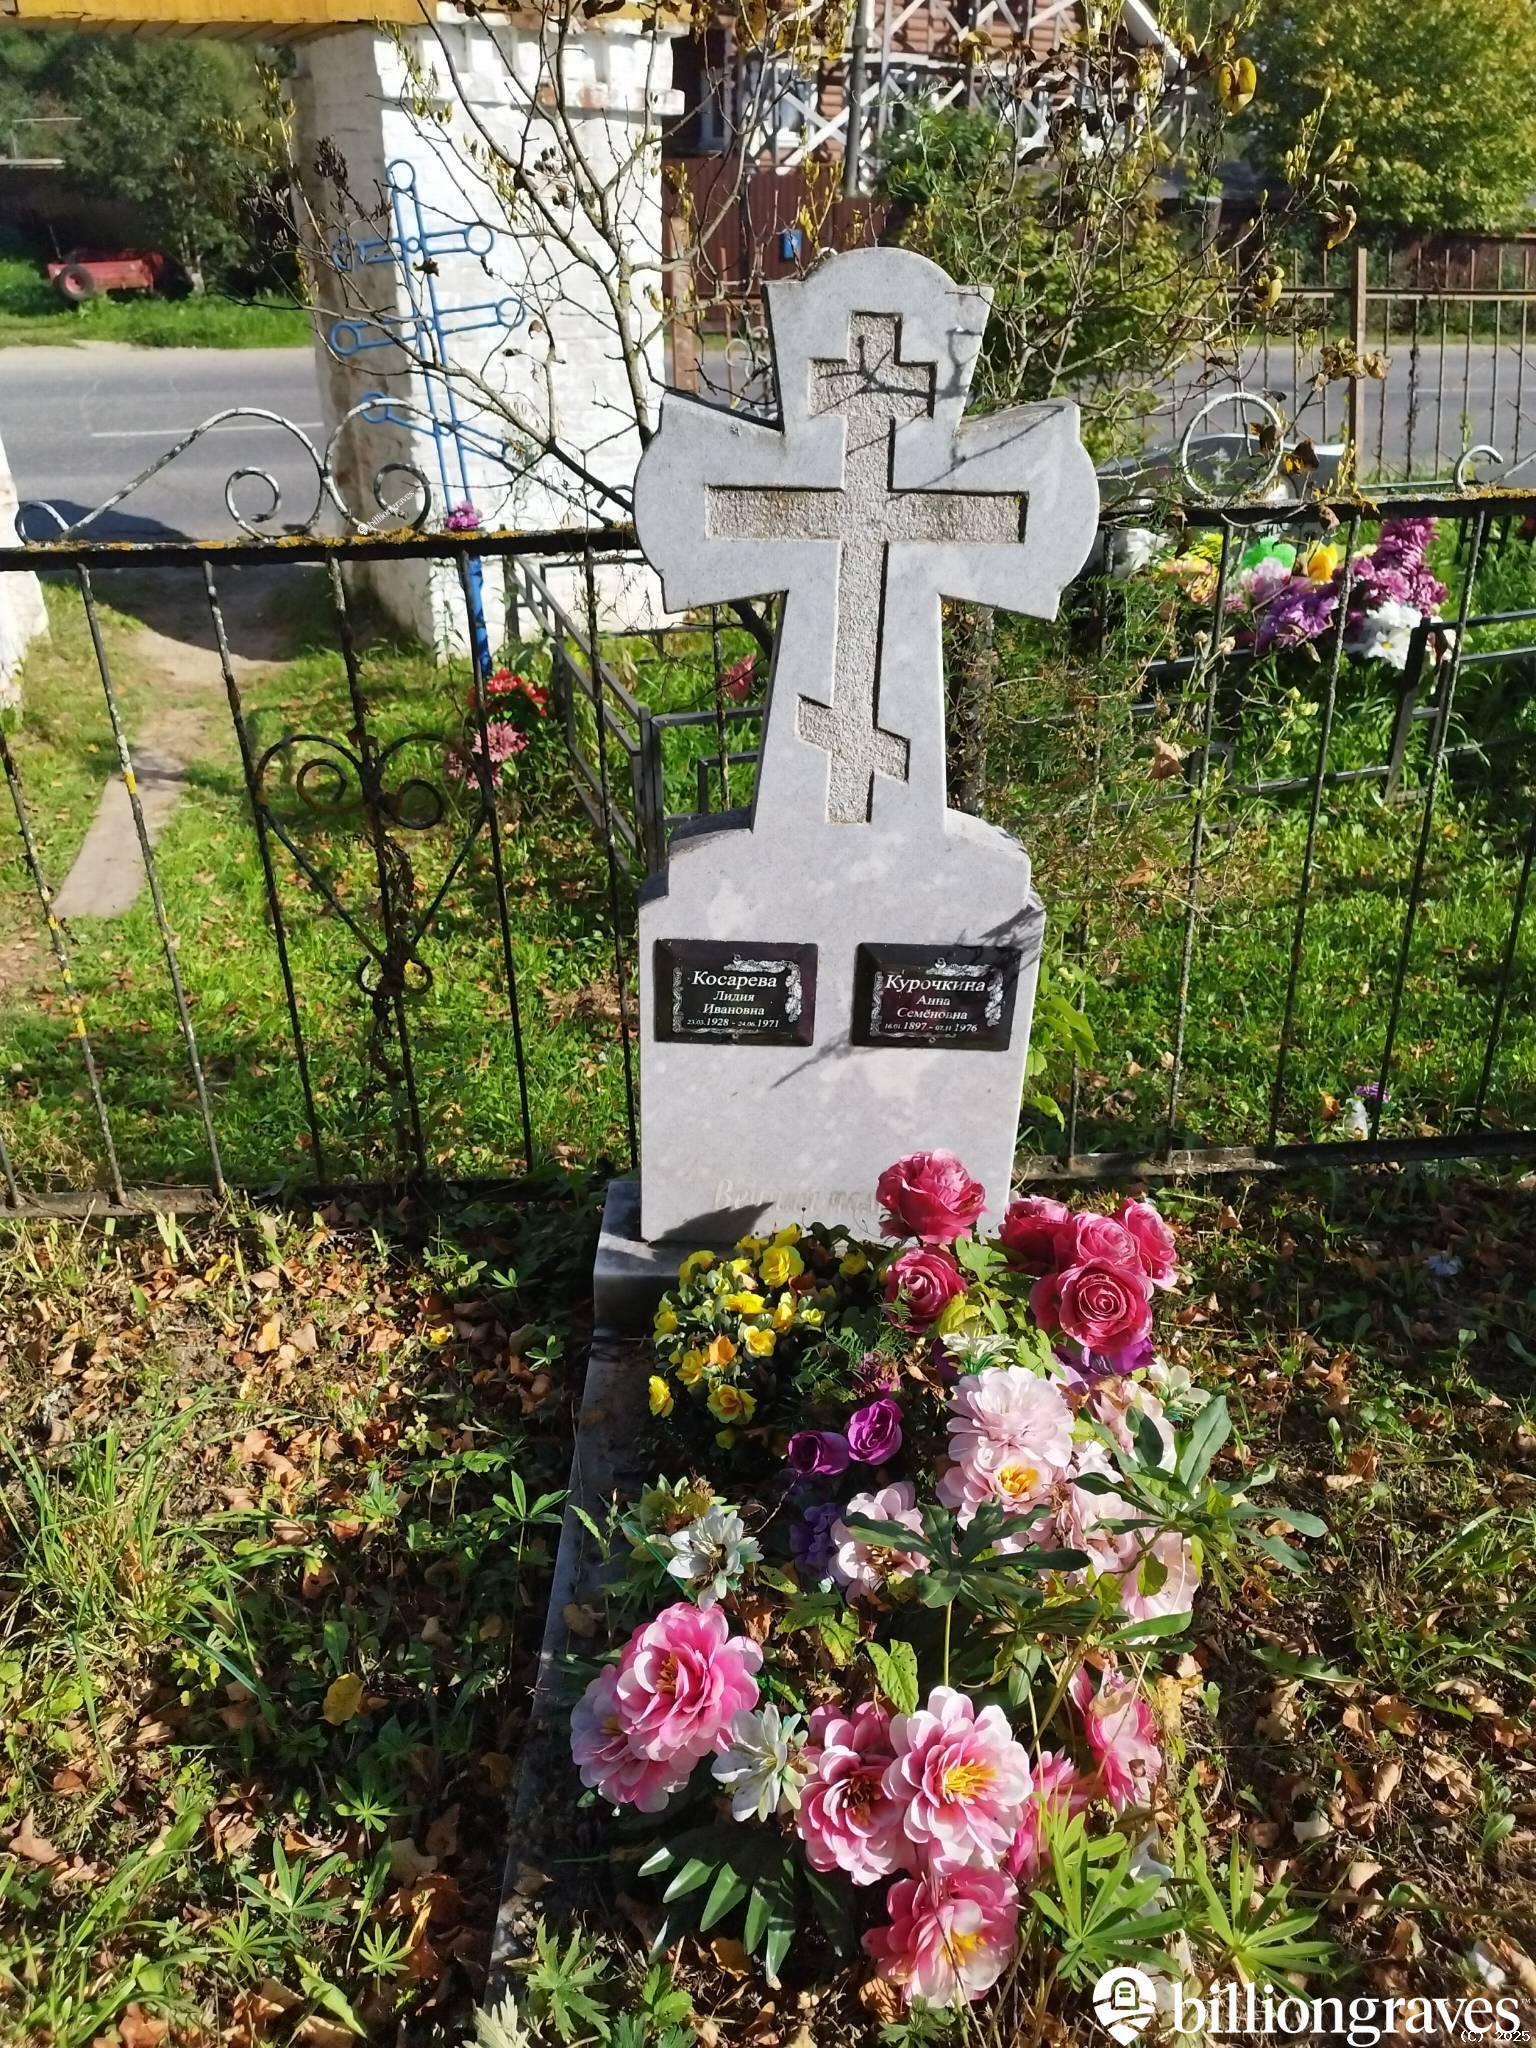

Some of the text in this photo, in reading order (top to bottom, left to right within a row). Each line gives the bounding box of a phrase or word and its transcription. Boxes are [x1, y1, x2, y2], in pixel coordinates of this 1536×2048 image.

[692, 971, 777, 990] Косарева
[885, 975, 986, 993] Курочкина
[713, 991, 755, 1001] Лидия
[916, 995, 950, 1006] Анна
[703, 1003, 765, 1015] Ивановна
[897, 1007, 968, 1020] Семёновна
